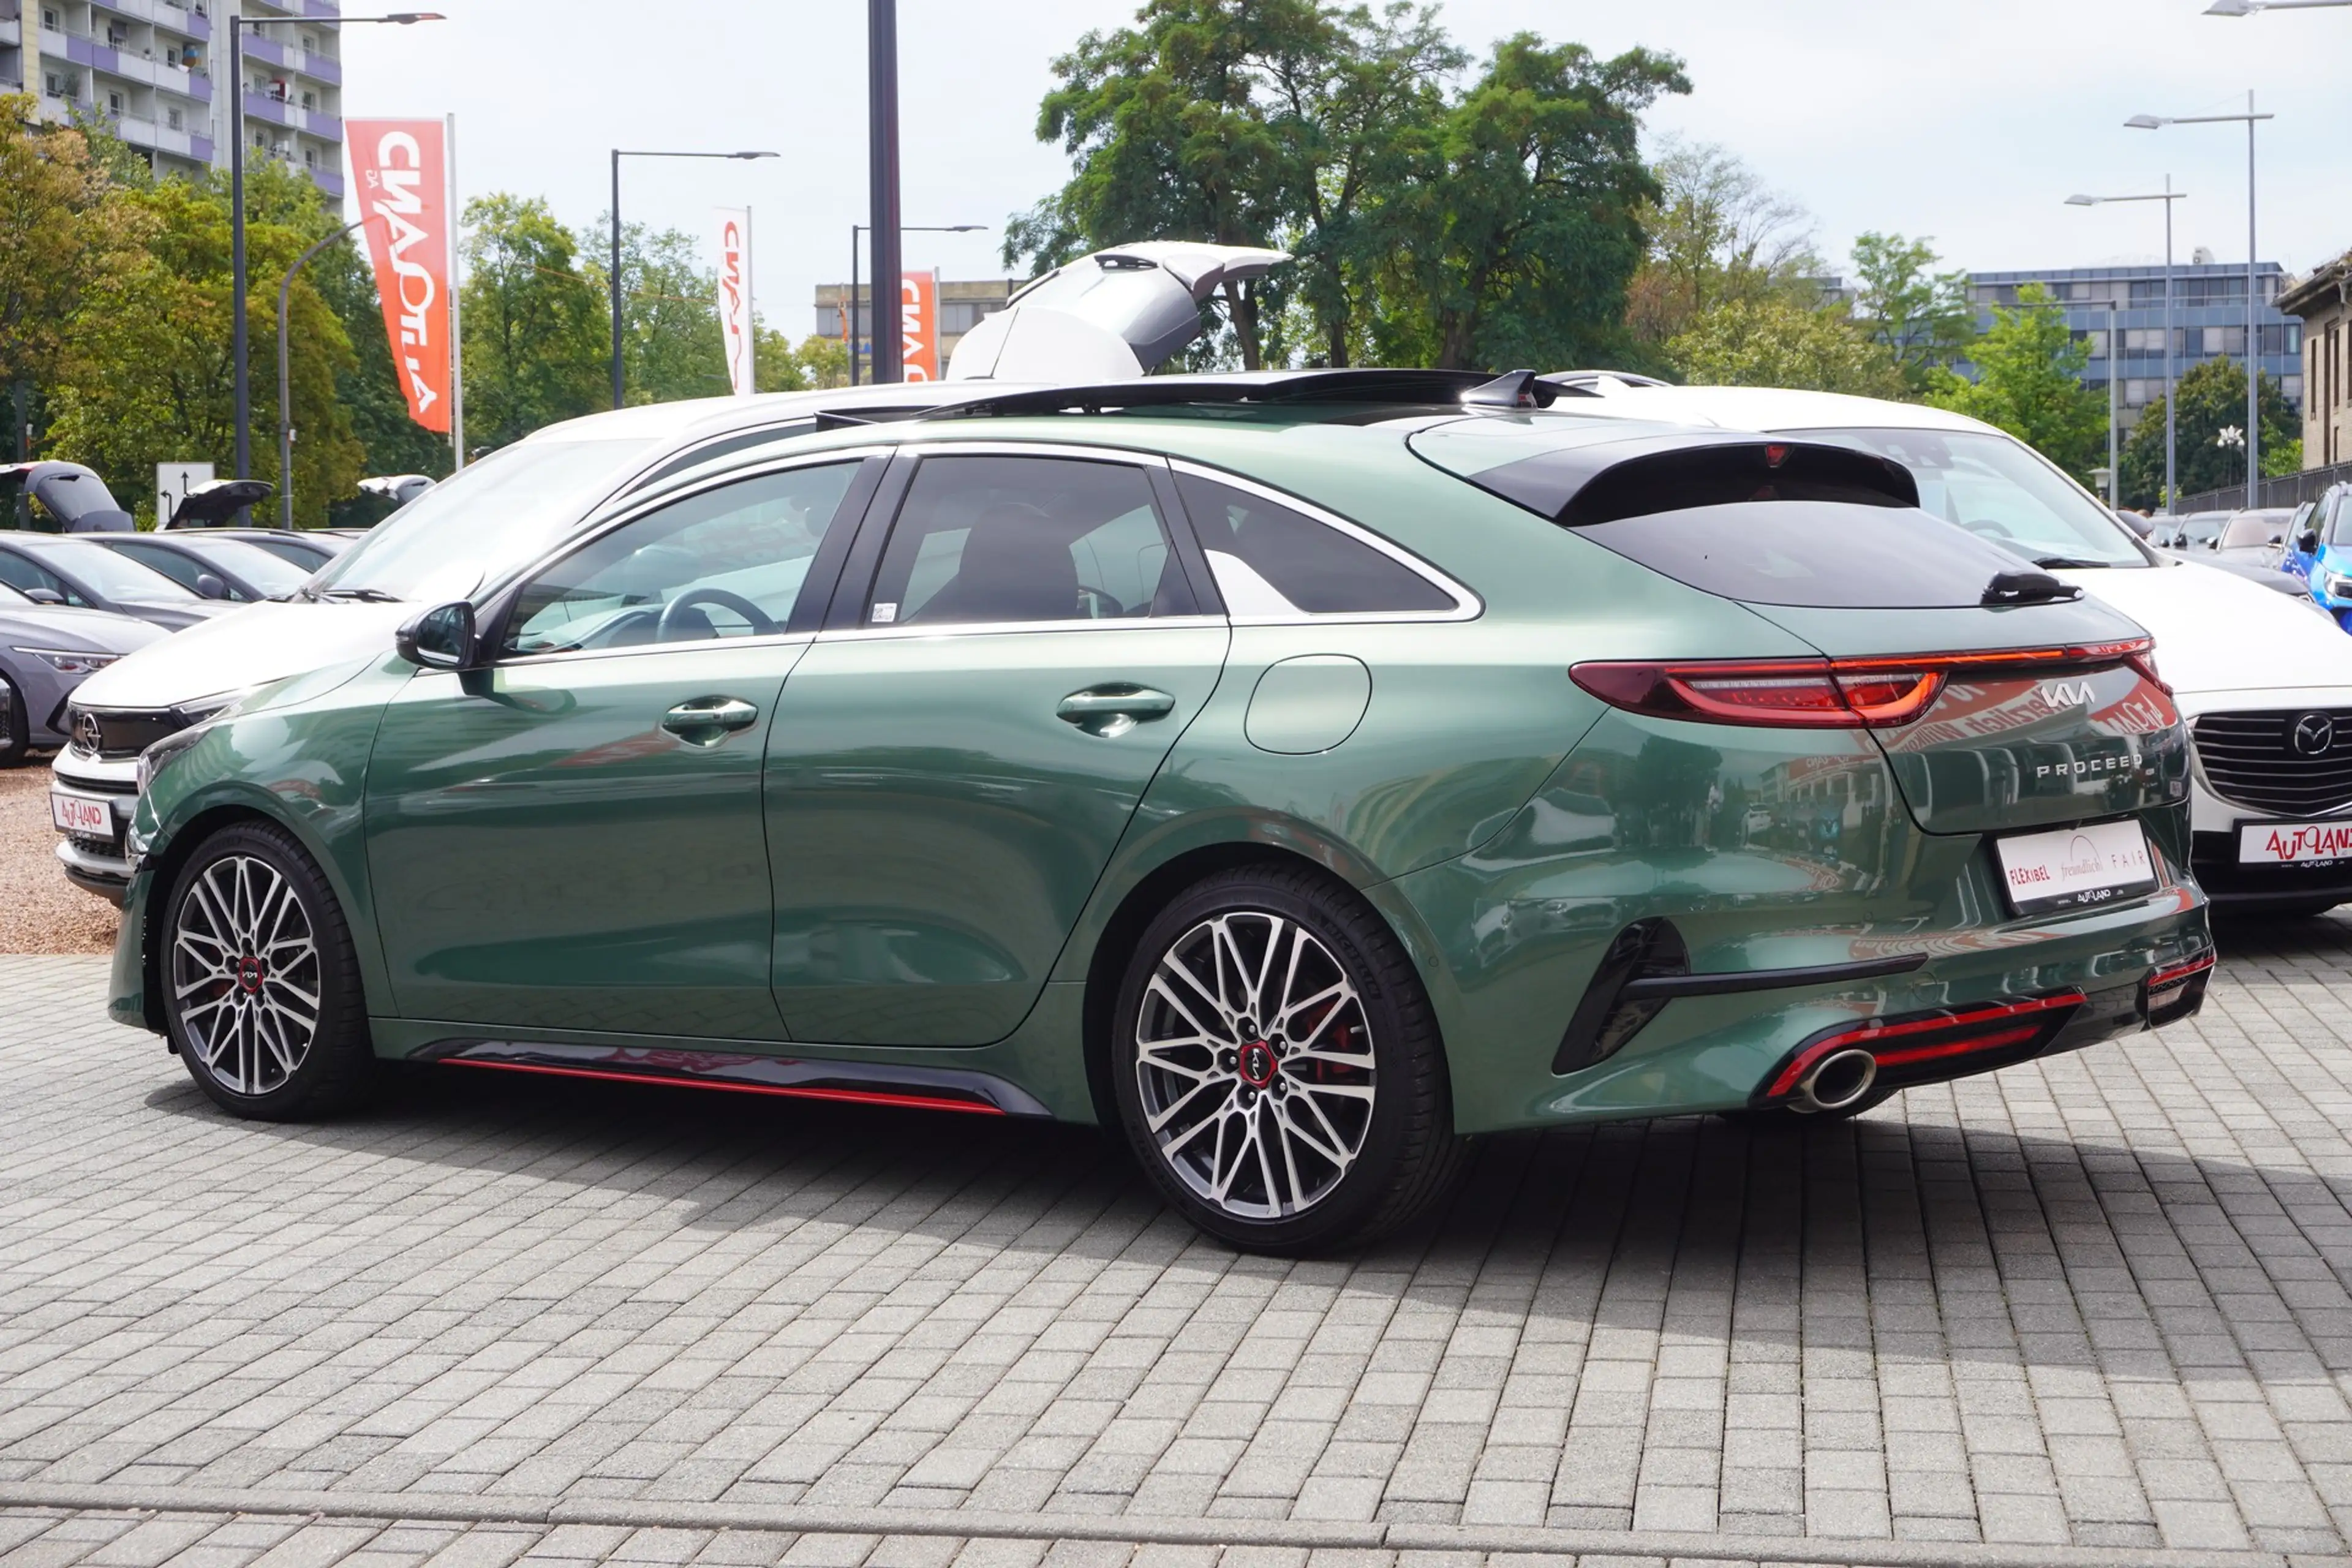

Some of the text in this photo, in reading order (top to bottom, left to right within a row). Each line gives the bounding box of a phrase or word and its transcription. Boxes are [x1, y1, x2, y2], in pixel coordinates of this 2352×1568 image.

[2037, 753, 2143, 778] PROCEED
[61, 799, 102, 830] AUTOLAND
[2009, 864, 2051, 886] FLEXIBEL
